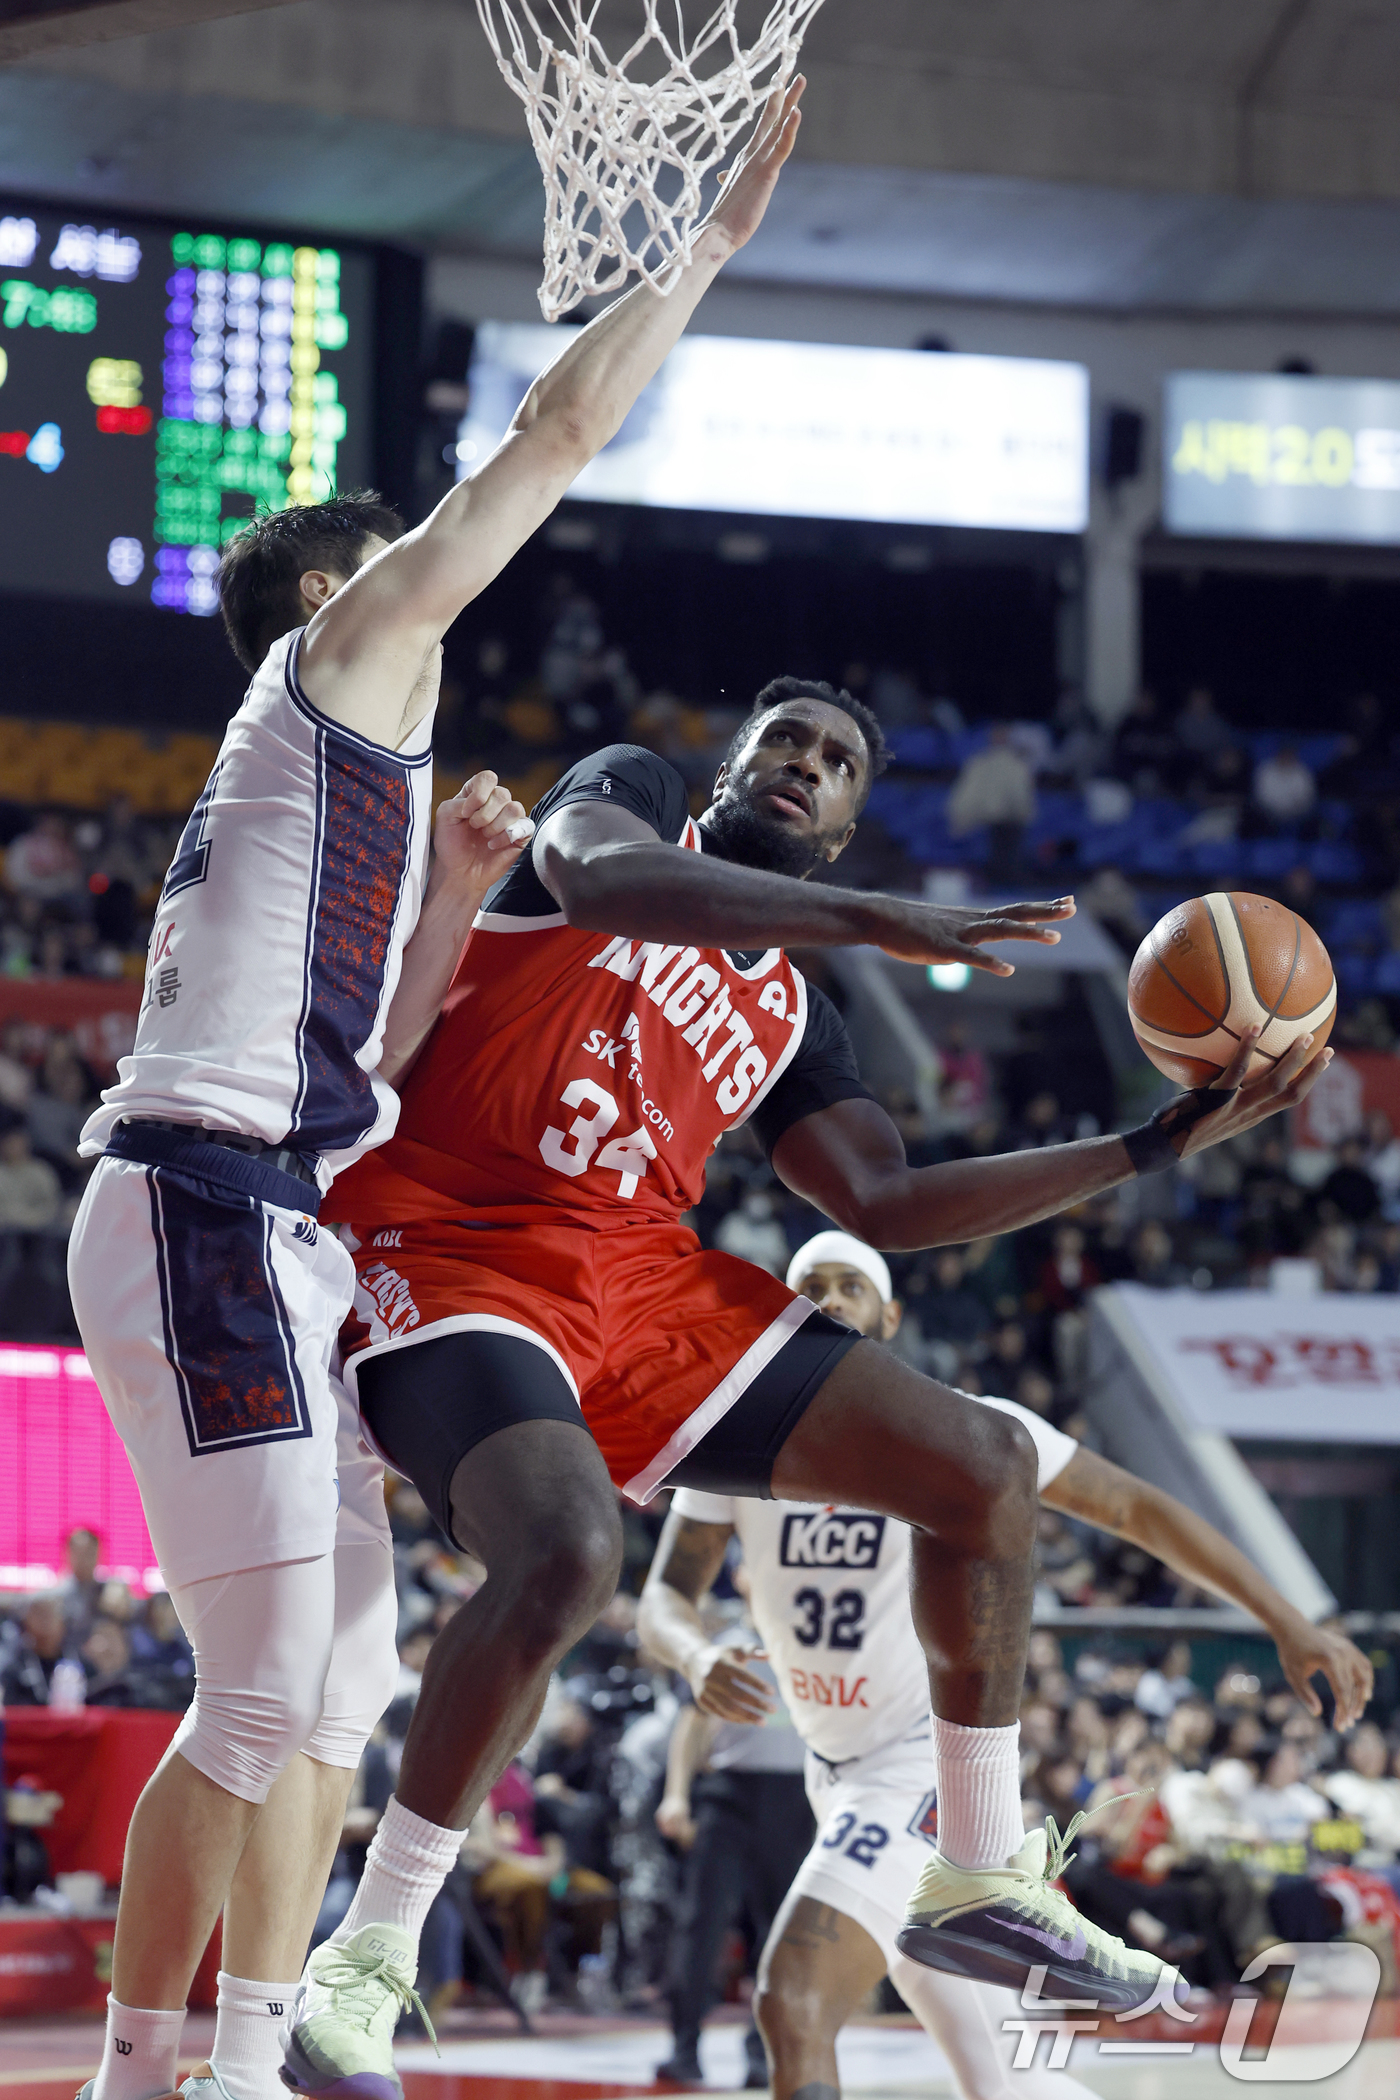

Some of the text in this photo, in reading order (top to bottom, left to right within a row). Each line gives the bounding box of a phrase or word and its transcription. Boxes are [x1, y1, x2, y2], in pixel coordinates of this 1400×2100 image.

[581, 1029, 674, 1142] SK tecom
[539, 1078, 657, 1199] 34
[373, 1229, 403, 1248] KBL
[786, 1508, 878, 1566] KCC
[794, 1588, 865, 1650] 32
[790, 1667, 869, 1708] BNK
[822, 1811, 890, 1870] 32
